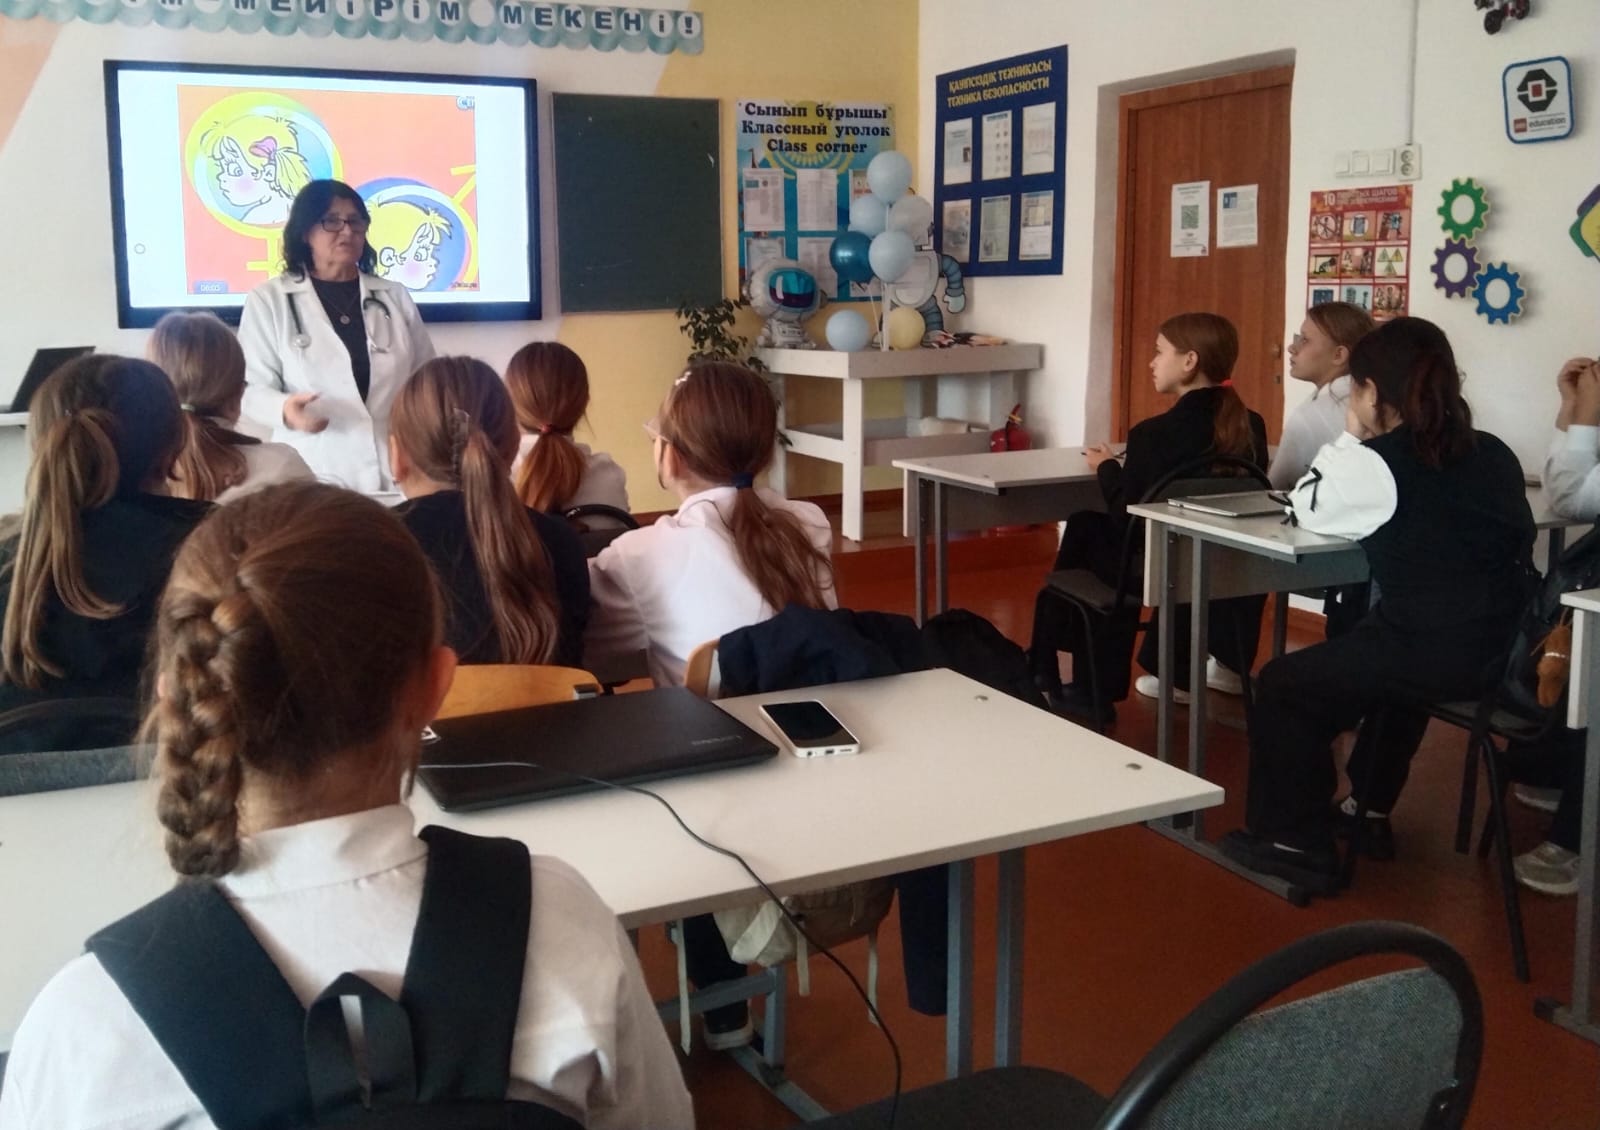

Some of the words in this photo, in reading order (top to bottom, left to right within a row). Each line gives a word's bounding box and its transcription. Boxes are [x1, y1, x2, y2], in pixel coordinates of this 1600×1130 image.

[998, 59, 1053, 81] ТЕХНИКАСЫ
[947, 91, 982, 108] ТЕХНИКА
[982, 76, 1050, 101] БЕЗОПАСНОСТИ
[745, 102, 807, 117] Сынып
[815, 105, 887, 120] бұрышы
[742, 120, 827, 135] Классный
[835, 125, 891, 137] уголок
[767, 138, 807, 152] Class
[816, 141, 867, 153] corner
[1323, 193, 1336, 207] 10
